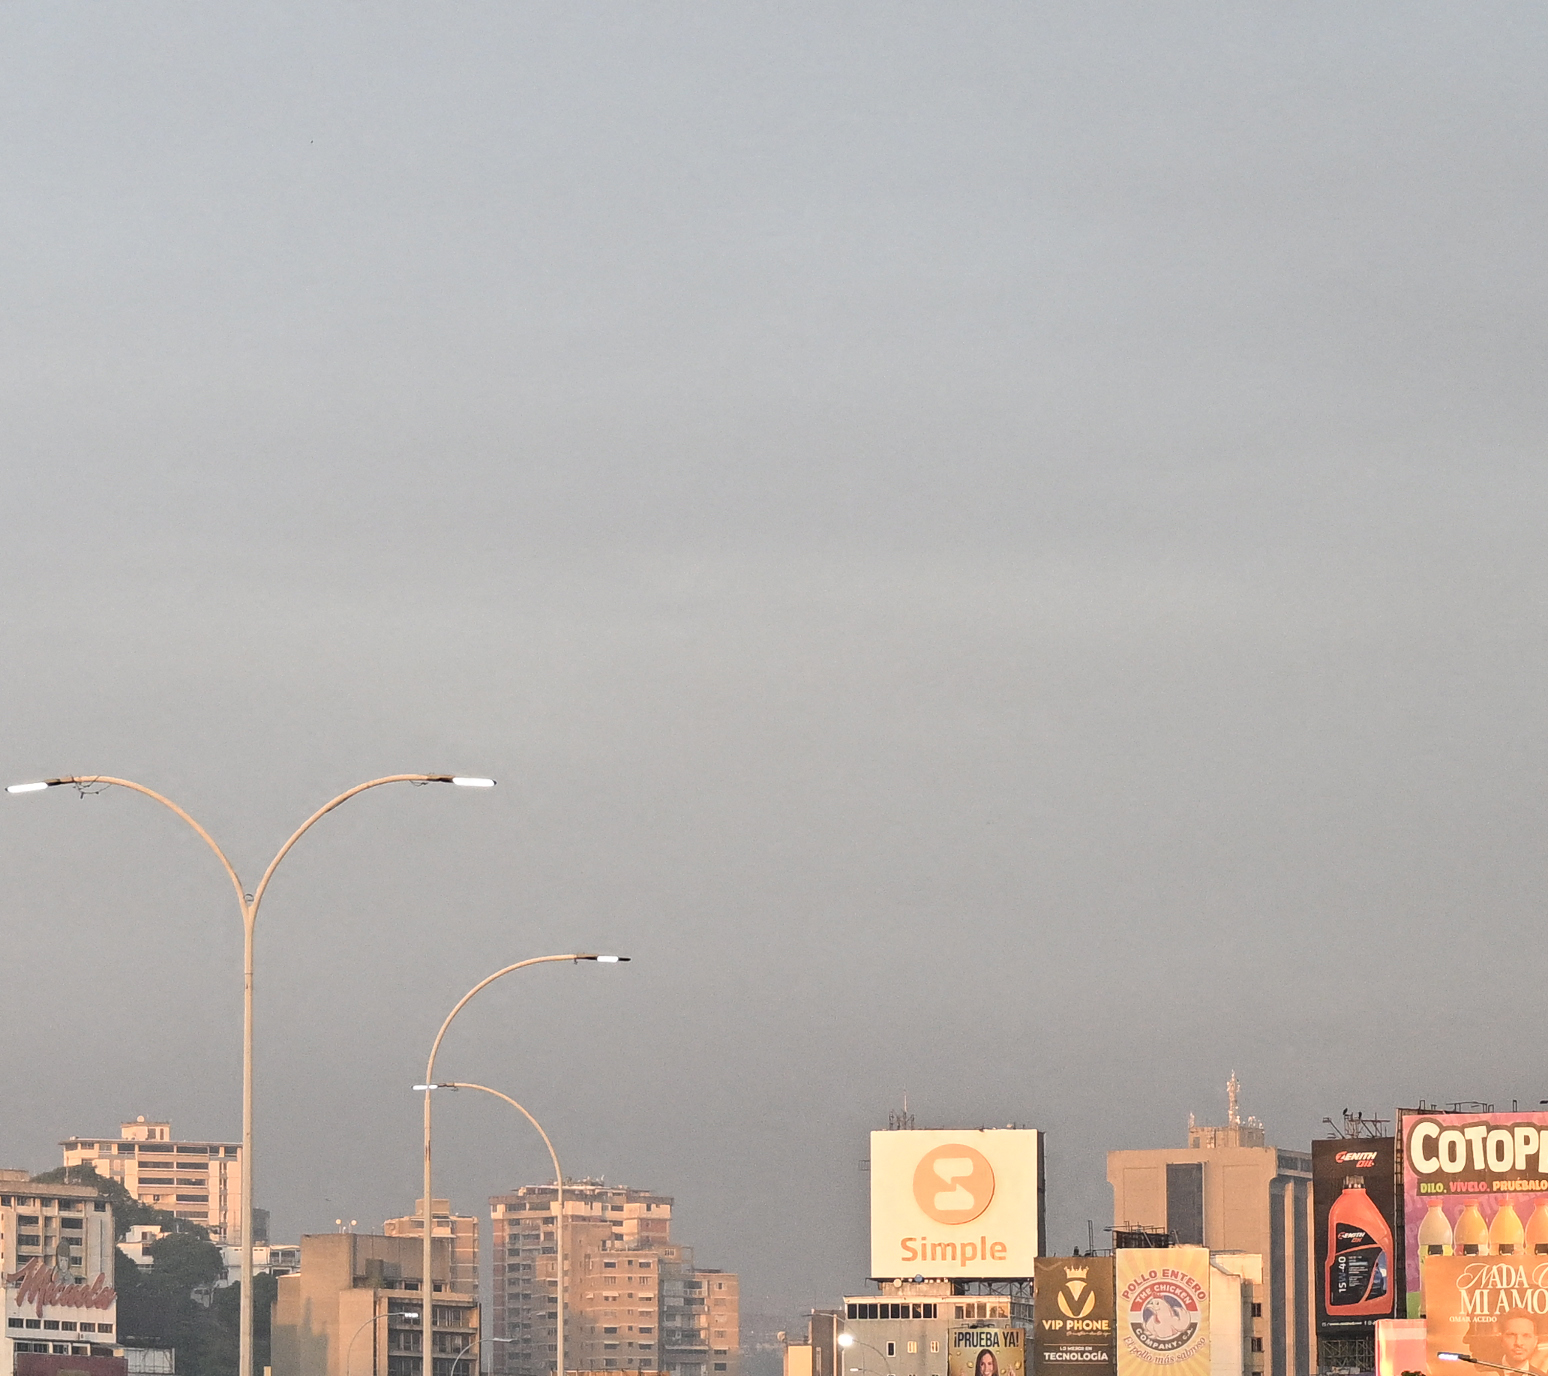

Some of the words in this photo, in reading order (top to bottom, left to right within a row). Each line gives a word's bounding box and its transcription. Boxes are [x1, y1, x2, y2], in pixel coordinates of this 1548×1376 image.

[1335, 1151, 1378, 1164] ZENITH
[1420, 1182, 1447, 1194] DILO.
[1449, 1180, 1490, 1193] VÍVELO.
[1492, 1178, 1548, 1192] PRUÉBALO
[900, 1236, 1008, 1267] Simple
[1121, 1269, 1158, 1301] POLLO
[1162, 1269, 1207, 1302] ENTERO
[1338, 1256, 1347, 1293] 15W-40
[1456, 1262, 1530, 1290] NADA
[1135, 1287, 1152, 1304] THE
[1154, 1283, 1192, 1305] CHICKEN
[1459, 1288, 1490, 1315] MI
[1042, 1320, 1064, 1330] VIP
[1066, 1320, 1109, 1330] PHONE
[1449, 1315, 1471, 1323] OMAR
[1472, 1315, 1498, 1323] ACEDO
[954, 1331, 1000, 1348] ¡PRUEBA
[1002, 1331, 1020, 1347] YA!
[1130, 1345, 1153, 1364] pollo
[1154, 1350, 1175, 1365] más
[1175, 1336, 1207, 1362] sabroso
[1043, 1351, 1109, 1361] TECNOLOGÍA
